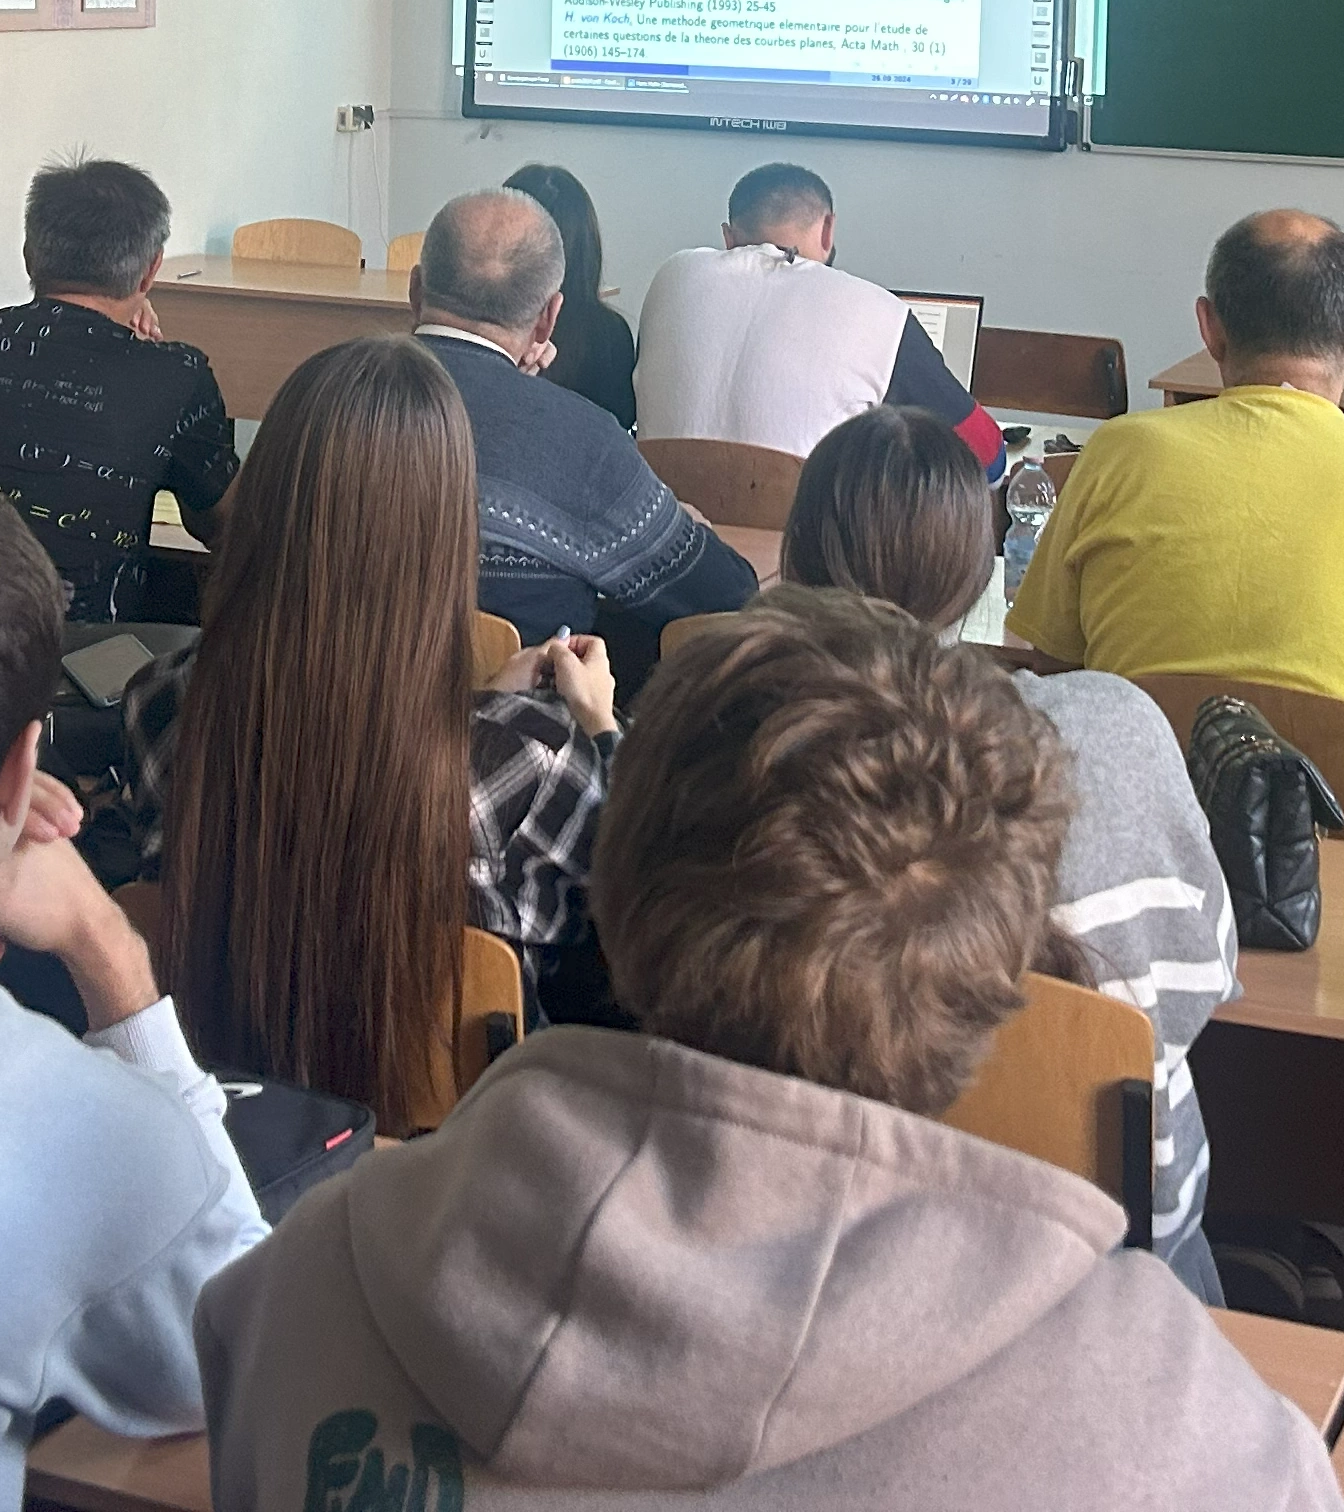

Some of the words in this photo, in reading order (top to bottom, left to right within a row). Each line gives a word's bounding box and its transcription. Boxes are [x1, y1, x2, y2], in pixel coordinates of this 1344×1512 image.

[581, 14, 599, 23] von
[603, 11, 633, 26] Koch,
[636, 14, 658, 25] Une
[661, 16, 707, 27] methode
[710, 17, 775, 31] geometrique
[779, 19, 841, 32] elementaire
[845, 23, 870, 34] pour
[915, 24, 928, 35] de
[563, 29, 610, 40] certaines
[612, 32, 661, 44] questions
[664, 32, 677, 42] de
[681, 32, 690, 43] la
[694, 33, 730, 45] theorie
[733, 34, 752, 46] des
[754, 36, 796, 47] courbes
[799, 37, 836, 51] planes,
[841, 38, 866, 50] Acta
[911, 41, 925, 53] 30
[929, 41, 946, 56] (1)
[563, 44, 598, 59] (1906)
[709, 117, 760, 129] INTECH
